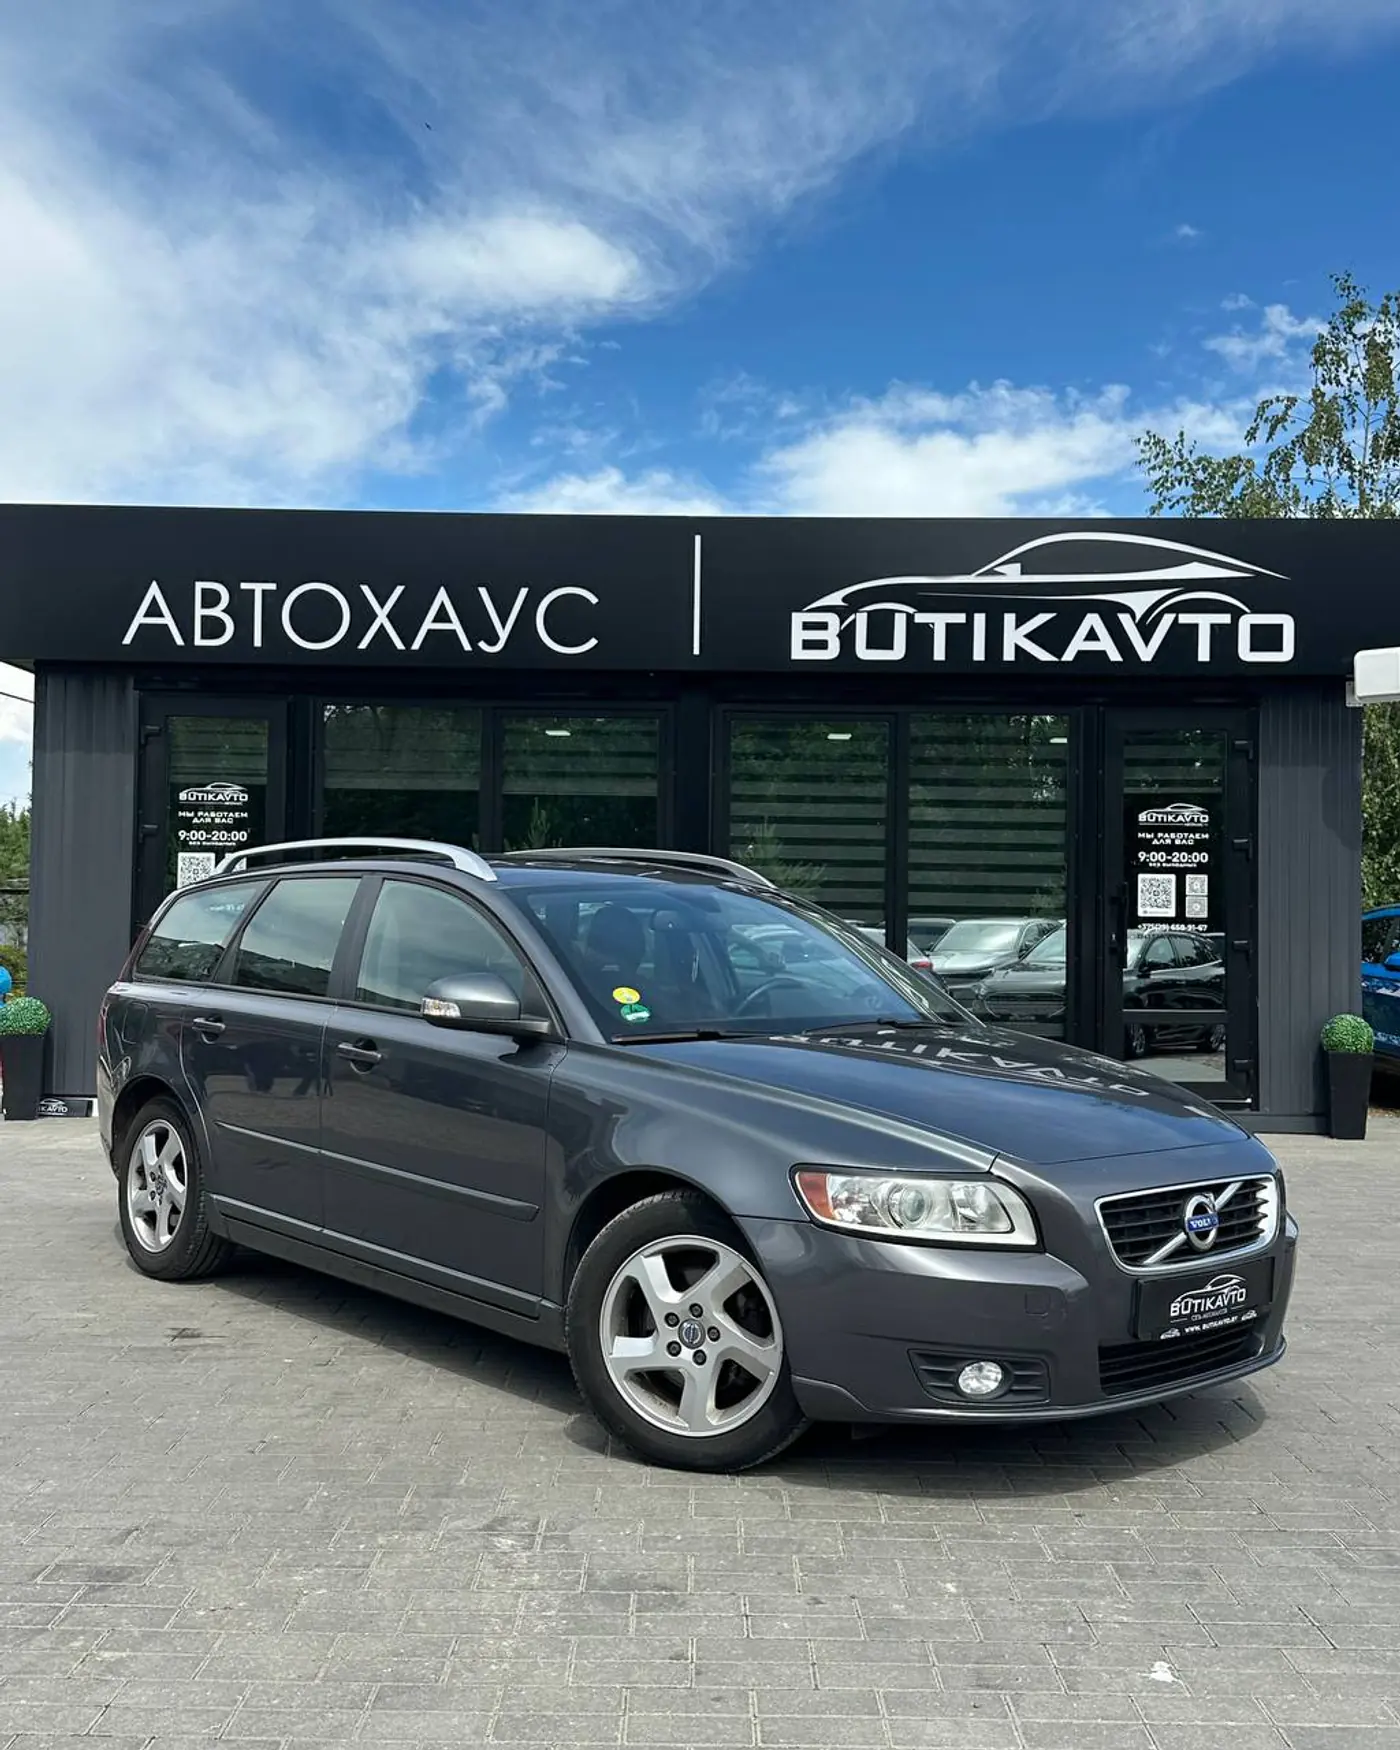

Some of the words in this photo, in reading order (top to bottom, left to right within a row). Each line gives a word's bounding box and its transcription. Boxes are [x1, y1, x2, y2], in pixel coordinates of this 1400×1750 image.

[121, 580, 599, 655] АВТОХАУС
[790, 612, 1295, 663] BUTIKAVTO
[1138, 813, 1209, 823] BUTIKAVTO
[178, 830, 248, 841] 9:00-20:00
[1138, 851, 1209, 863] 9:00-20:00
[1170, 1288, 1246, 1316] BUTIKAVTO
